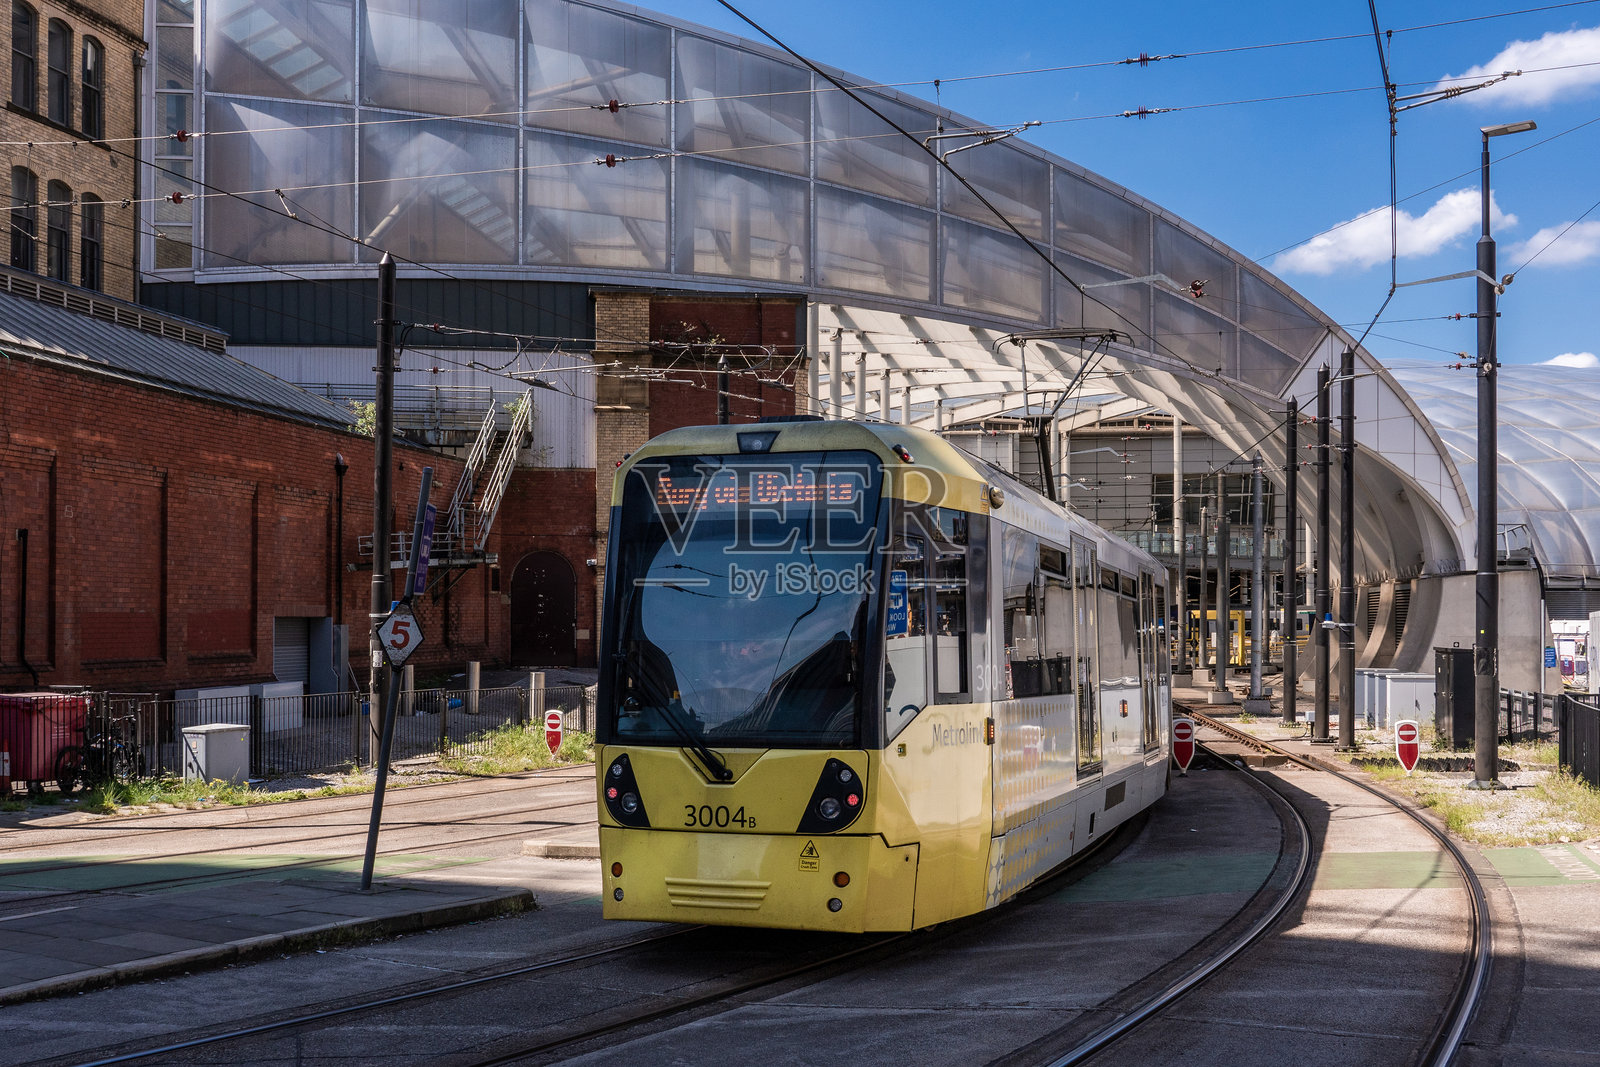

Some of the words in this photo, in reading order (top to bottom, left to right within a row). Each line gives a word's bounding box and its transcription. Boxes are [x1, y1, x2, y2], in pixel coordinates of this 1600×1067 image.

[657, 477, 708, 510] Bury
[714, 476, 751, 503] via
[757, 473, 852, 502] Victoria
[390, 620, 410, 649] 5
[931, 720, 984, 749] Metrolink
